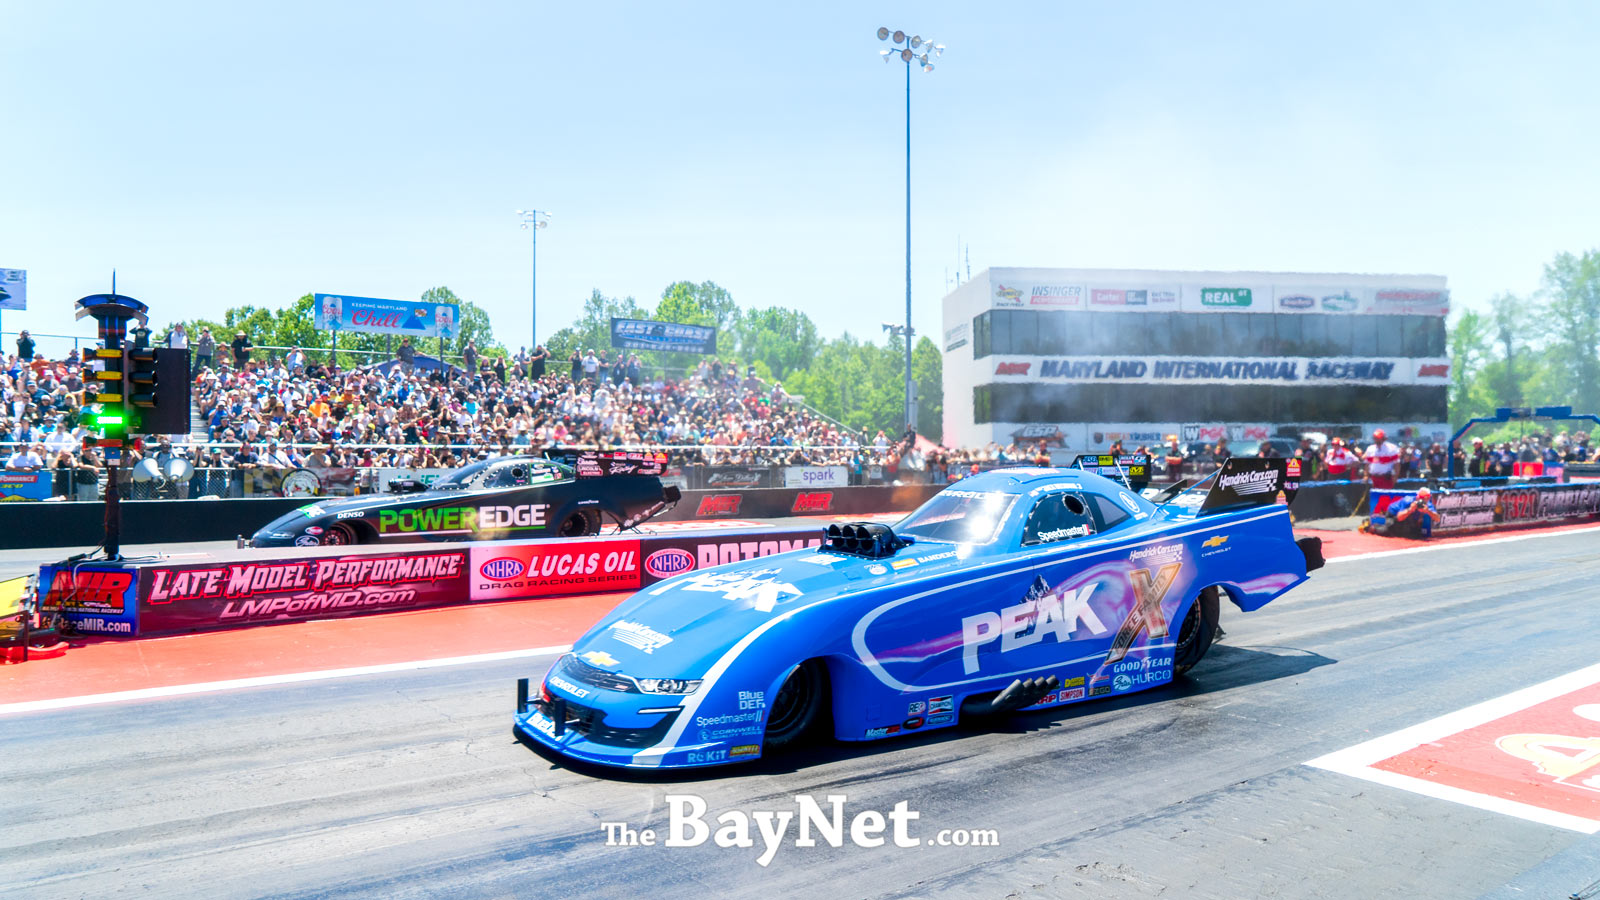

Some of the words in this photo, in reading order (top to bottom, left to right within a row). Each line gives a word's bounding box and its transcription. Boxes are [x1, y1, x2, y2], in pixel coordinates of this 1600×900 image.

[1032, 286, 1081, 297] INSINGER
[1205, 292, 1236, 304] REAL
[352, 309, 403, 328] Chill
[1039, 360, 1148, 378] MARYLAND
[1153, 361, 1298, 380] INTERNATIONAL
[1304, 361, 1396, 380] RACEWAY
[802, 468, 836, 484] spark
[337, 511, 364, 519] DENSO
[1037, 525, 1085, 542] Speedmaster
[486, 560, 524, 578] NHRA
[527, 552, 601, 578] LUCAS
[604, 551, 636, 573] OIL
[654, 553, 689, 572] NHRA
[151, 570, 222, 601] LATE
[226, 565, 309, 593] MODEL
[314, 555, 462, 588] PERFORMANCE
[479, 581, 524, 590] DRAG
[527, 577, 585, 587] RACING
[588, 574, 638, 583] SERIES
[219, 589, 416, 619] LMPofMD.com
[961, 582, 1107, 675] PEAK
[1113, 657, 1171, 673] GOODYEAR
[1131, 670, 1171, 685] HURCO
[739, 691, 764, 700] Blue
[1060, 688, 1084, 700] SIMPSON
[739, 700, 764, 710] DEF
[696, 713, 756, 728] Speedmaster
[712, 726, 760, 735] CORNWELL
